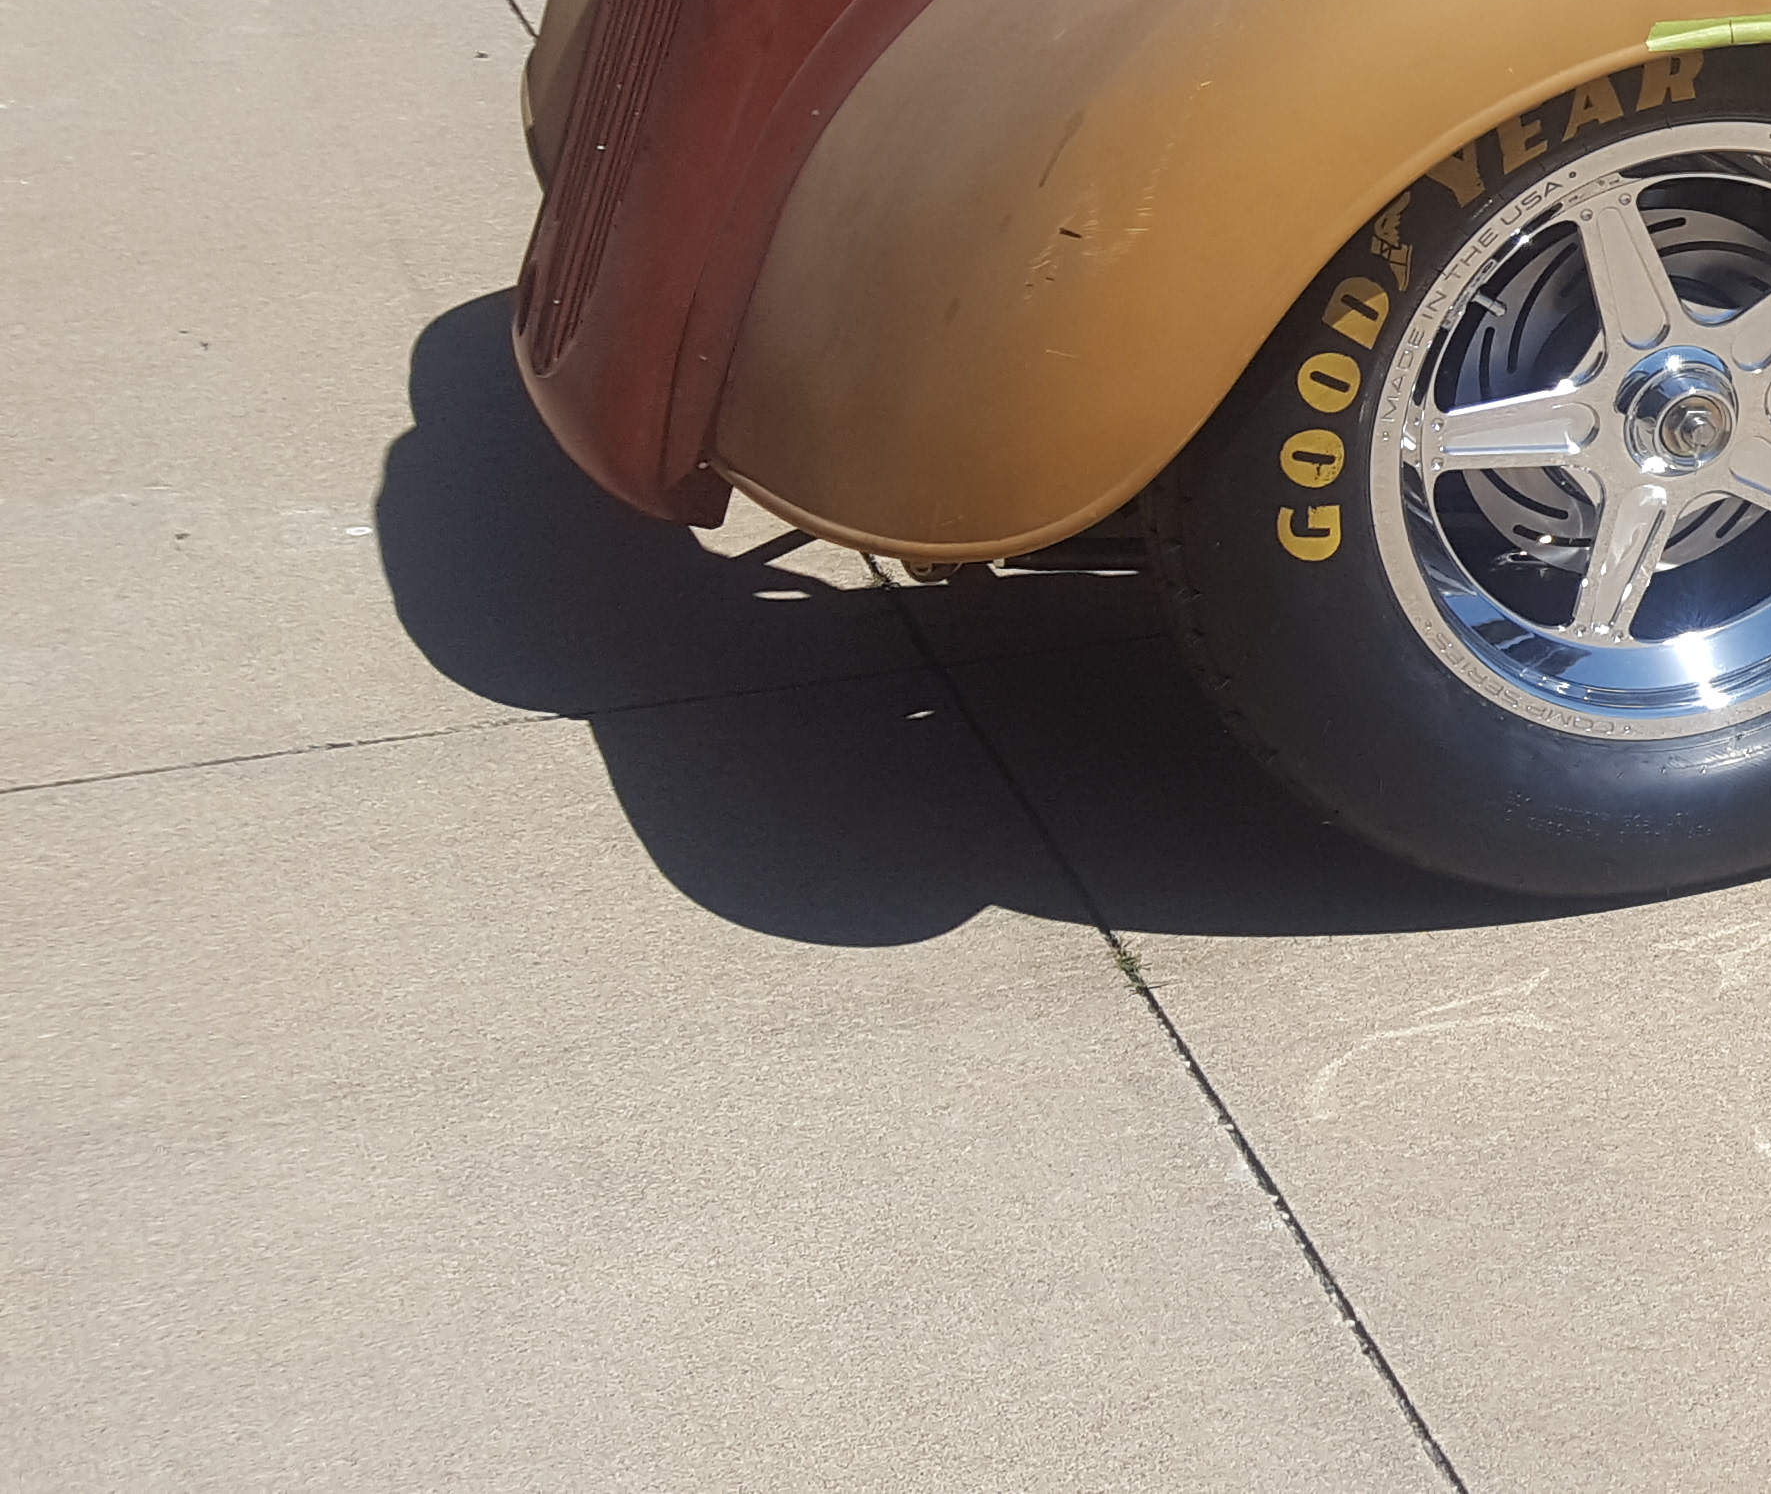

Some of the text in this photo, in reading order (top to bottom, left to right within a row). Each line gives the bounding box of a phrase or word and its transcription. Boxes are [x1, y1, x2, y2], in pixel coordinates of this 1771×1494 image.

[1381, 180, 1564, 423] MADE IN THE USA
